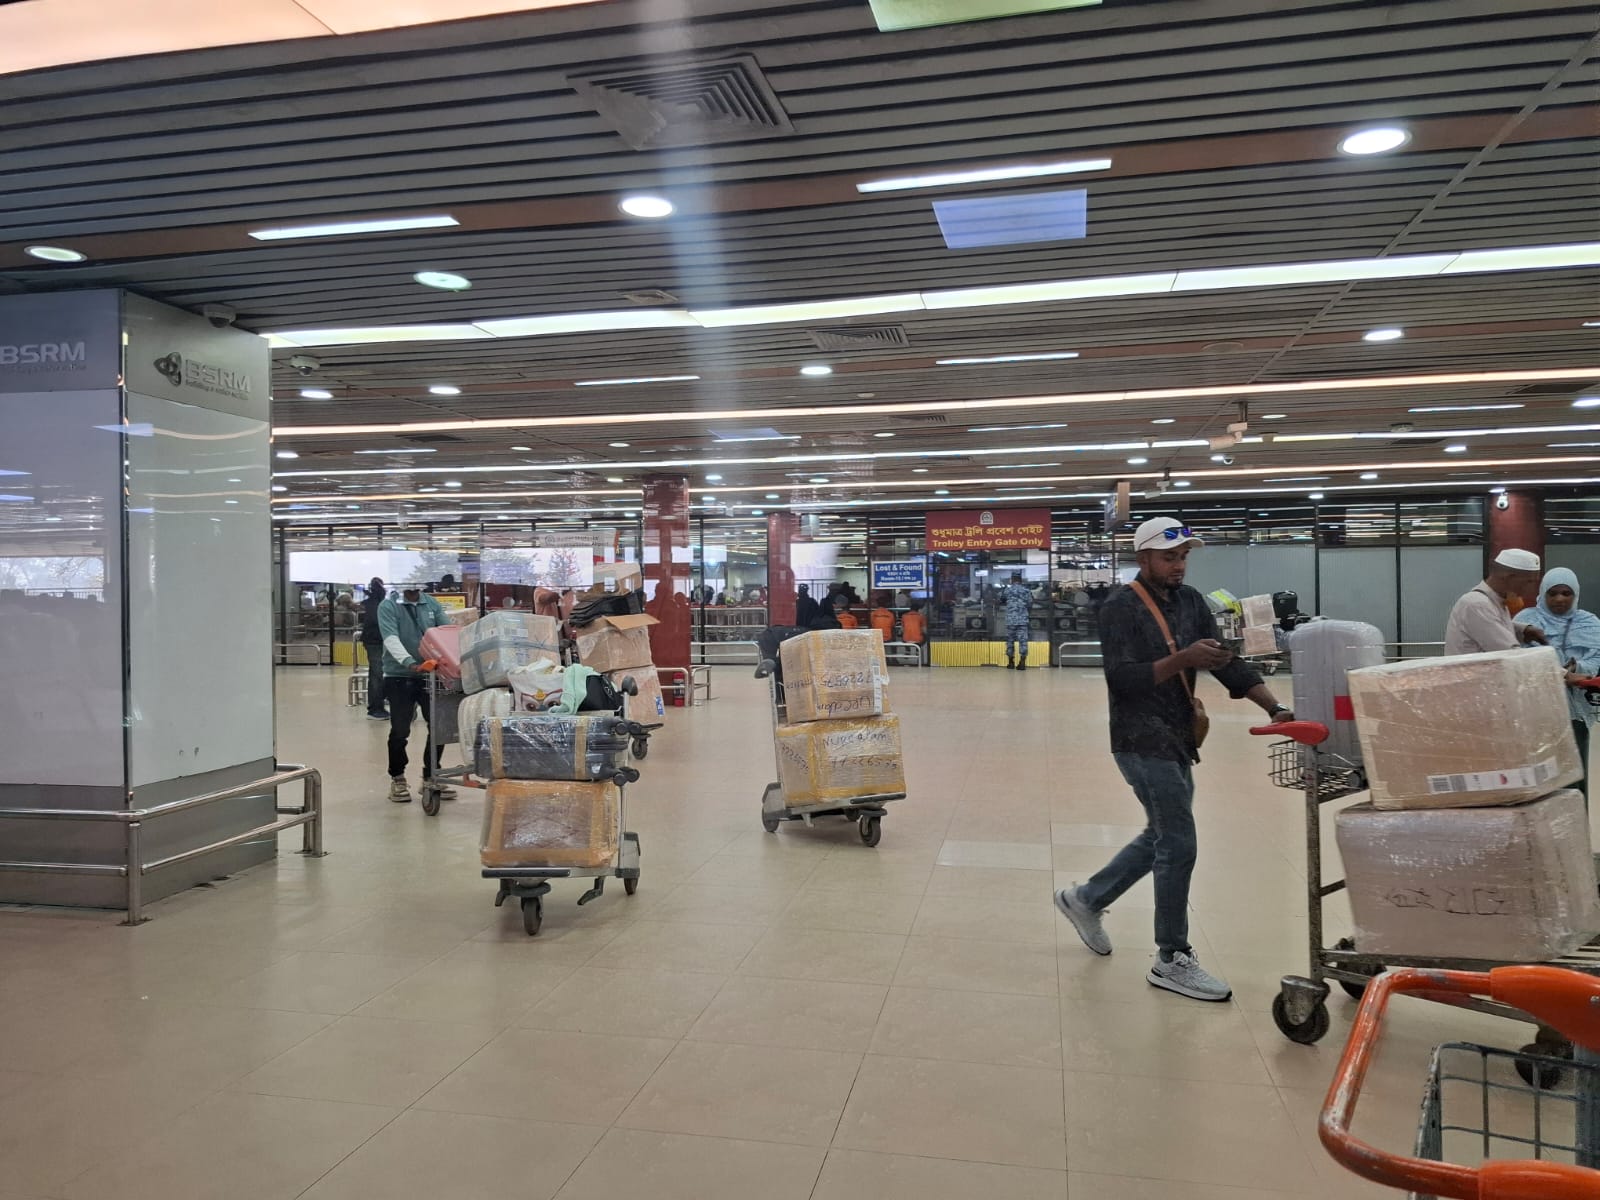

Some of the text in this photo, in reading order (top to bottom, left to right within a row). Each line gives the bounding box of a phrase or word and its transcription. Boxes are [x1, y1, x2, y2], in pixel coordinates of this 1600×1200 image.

[0, 341, 86, 366] BSRM
[185, 359, 250, 393] BSRM
[931, 527, 963, 538] শুধুমাত্র
[986, 526, 1014, 536] প্রবেশ
[1017, 524, 1044, 535] গেইট
[932, 537, 1043, 548] Trolley Entry Gate Only
[900, 563, 922, 571] Found
